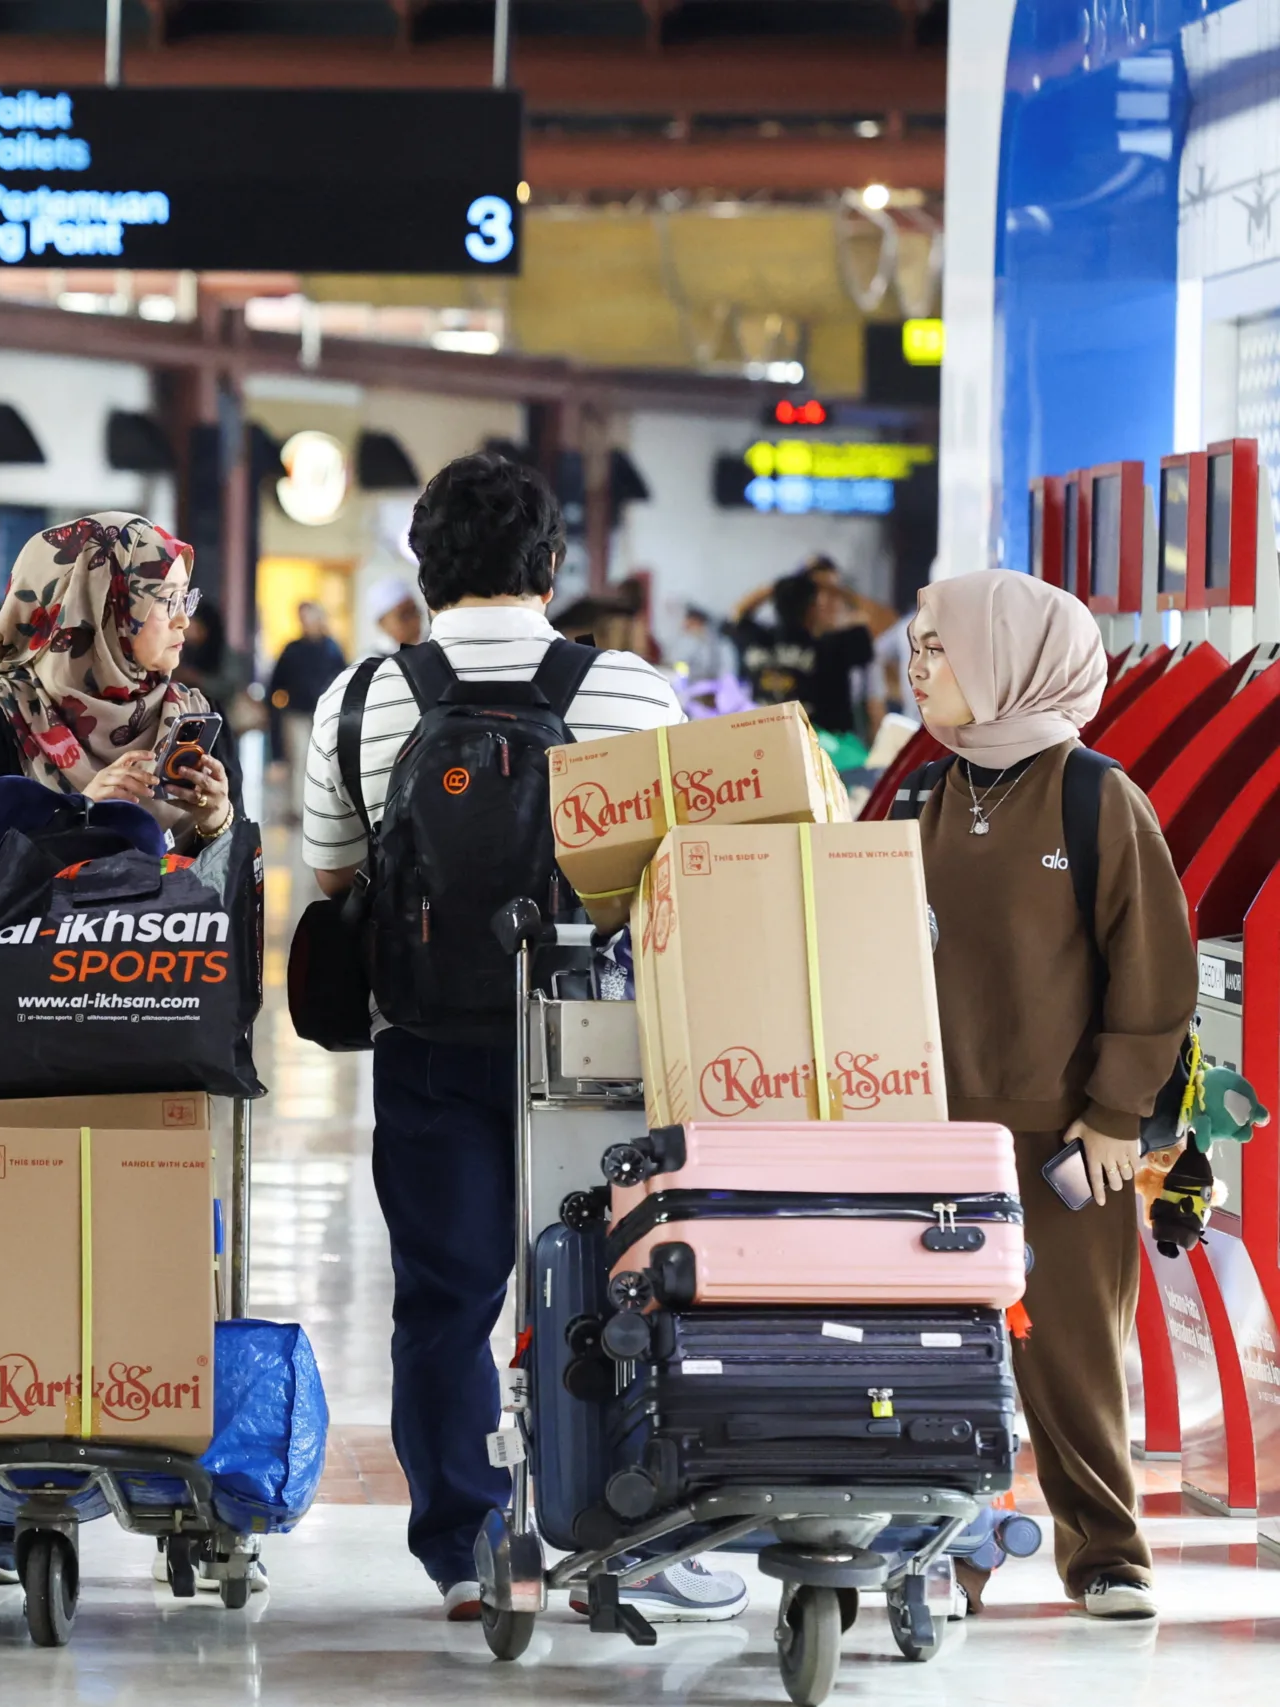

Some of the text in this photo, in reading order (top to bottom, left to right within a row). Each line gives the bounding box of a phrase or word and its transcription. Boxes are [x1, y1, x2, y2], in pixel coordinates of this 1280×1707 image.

[30, 214, 124, 256] Point
[465, 195, 514, 263] 3
[828, 850, 863, 859] HANDLE
[866, 850, 889, 858] WITH
[1041, 848, 1069, 870] alo
[49, 950, 229, 984] SPORTS
[18, 992, 200, 1009] www.al-ikhsan.com
[9, 1158, 28, 1166] THIS
[31, 1158, 50, 1166] SIDE
[121, 1160, 155, 1168] HANDLE
[182, 1161, 206, 1169] CARE
